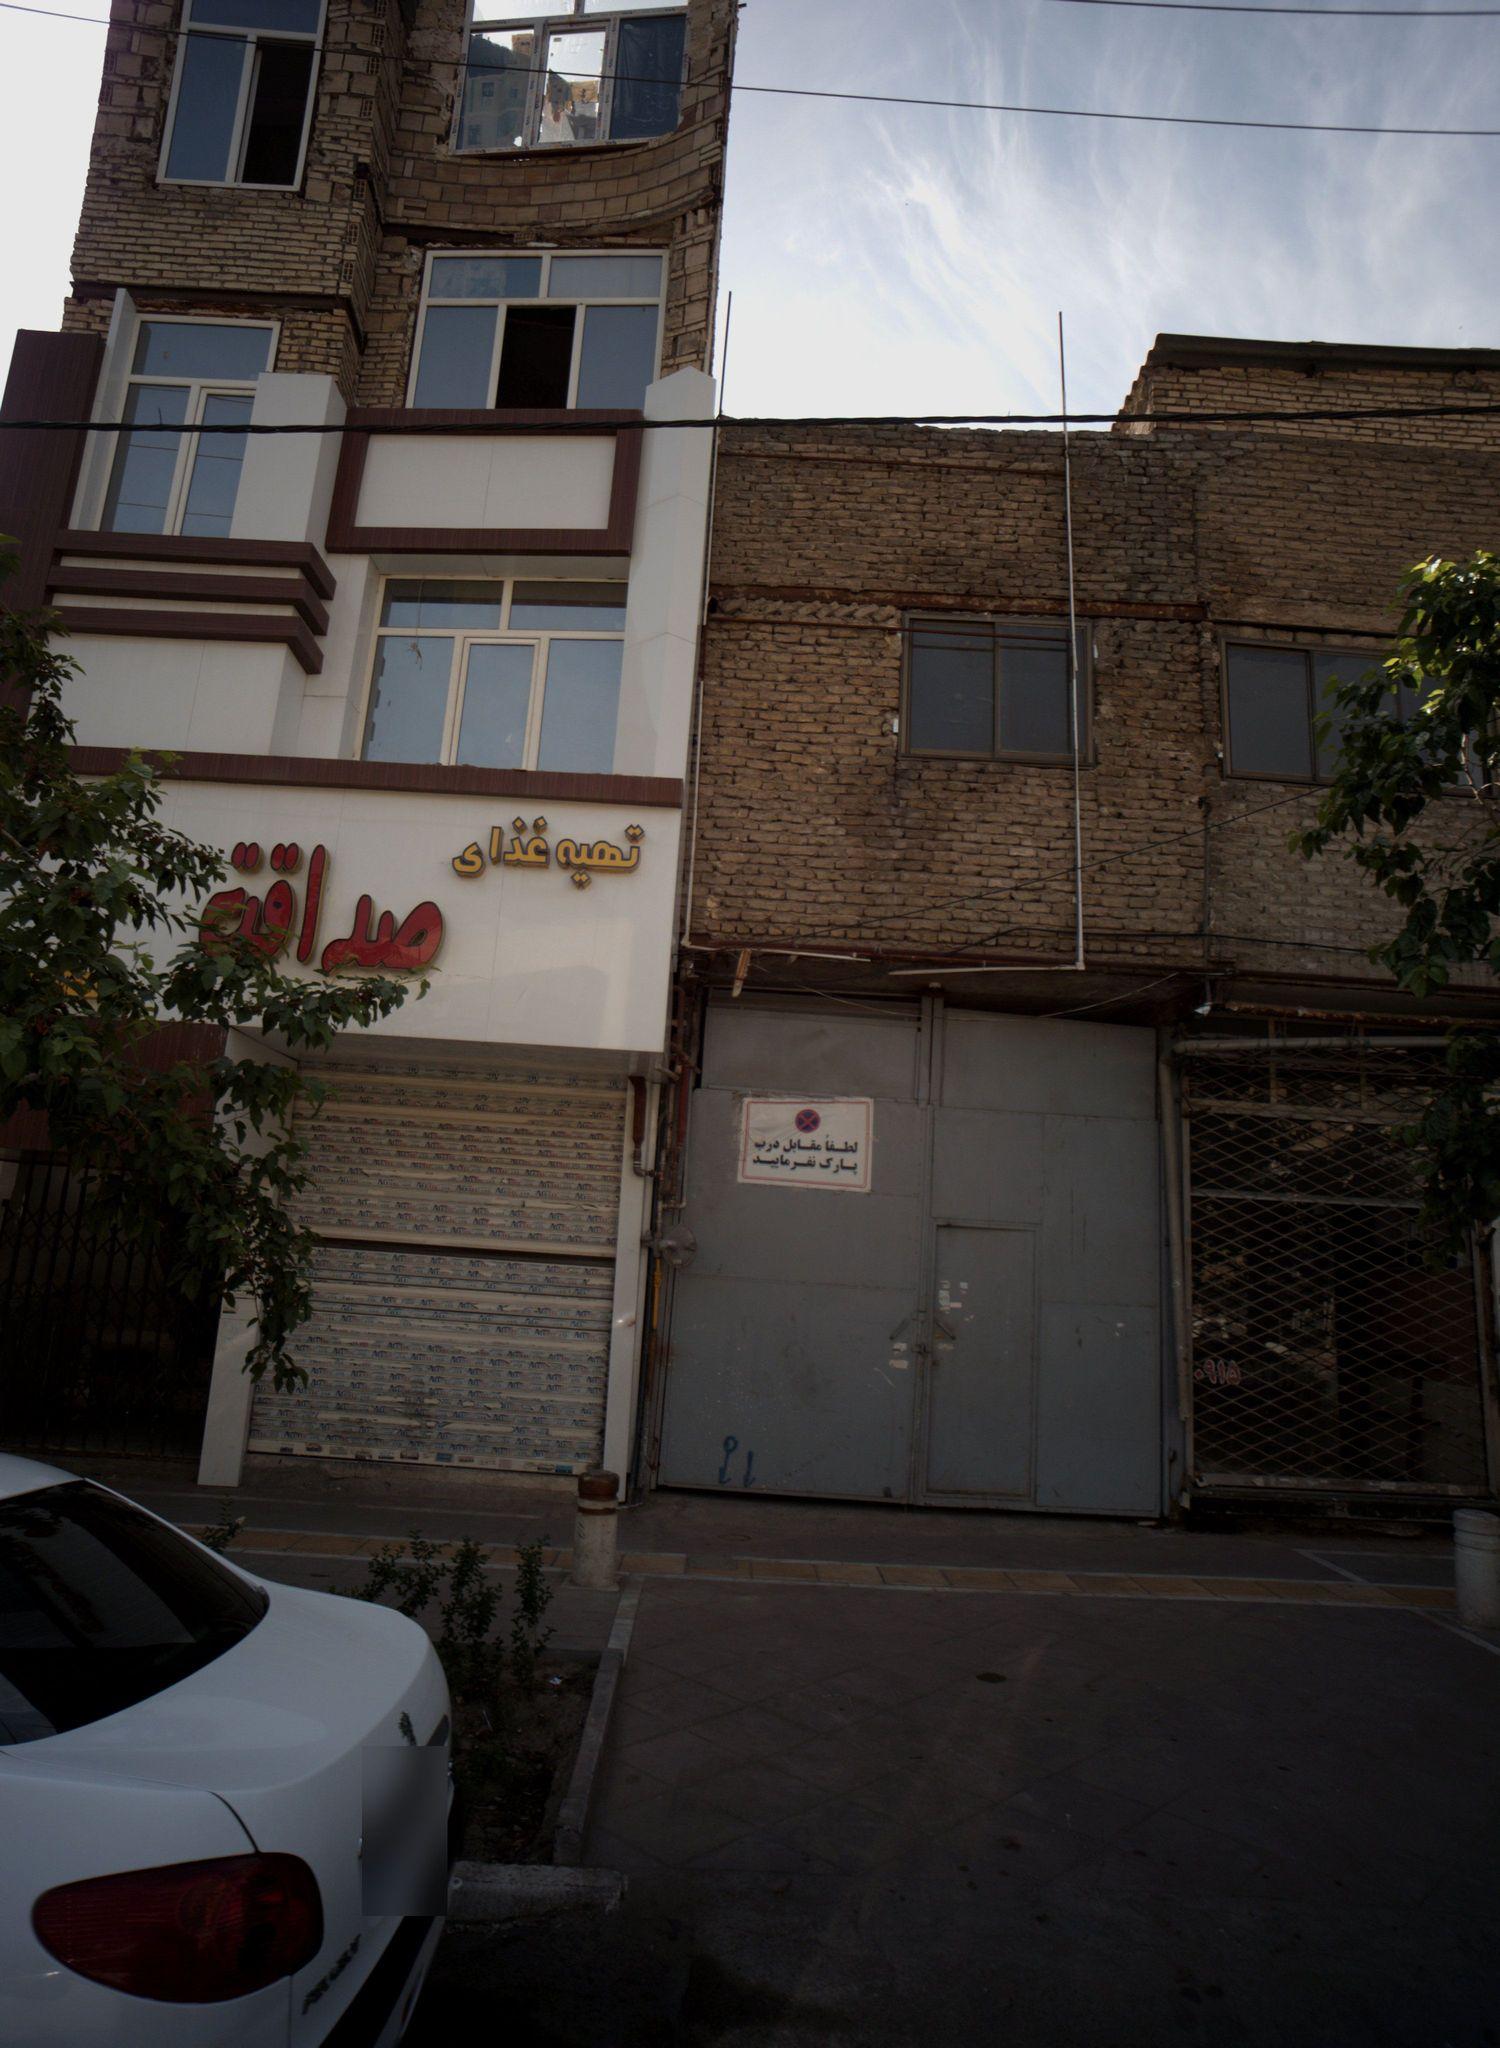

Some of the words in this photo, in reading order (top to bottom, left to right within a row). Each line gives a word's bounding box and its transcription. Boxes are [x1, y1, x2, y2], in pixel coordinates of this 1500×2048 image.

[452, 816, 549, 877] غذای
[555, 824, 645, 889] تهیه
[754, 1139, 780, 1153] درب
[783, 1138, 822, 1153] مقابل
[752, 1154, 816, 1171] نفرمایید
[819, 1157, 858, 1176] پارک
